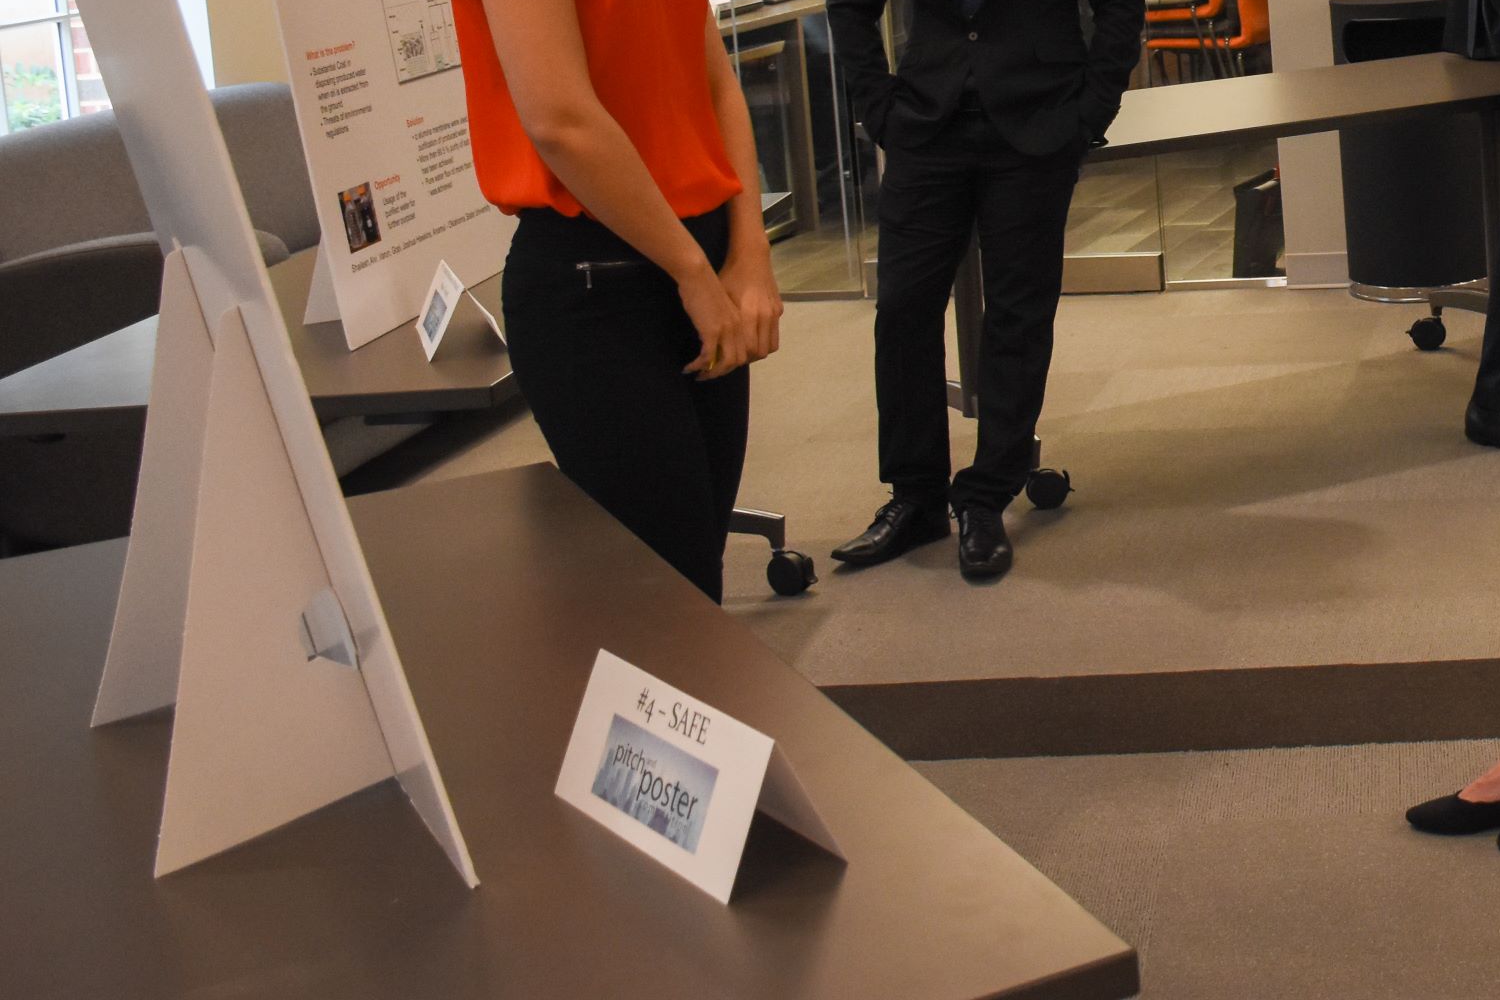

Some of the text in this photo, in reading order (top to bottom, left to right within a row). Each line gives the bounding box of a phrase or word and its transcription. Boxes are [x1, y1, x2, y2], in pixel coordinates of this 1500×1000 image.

[637, 688, 655, 723] #4
[668, 702, 711, 745] SAFE
[613, 743, 646, 773] pitch
[636, 769, 698, 820] poster
